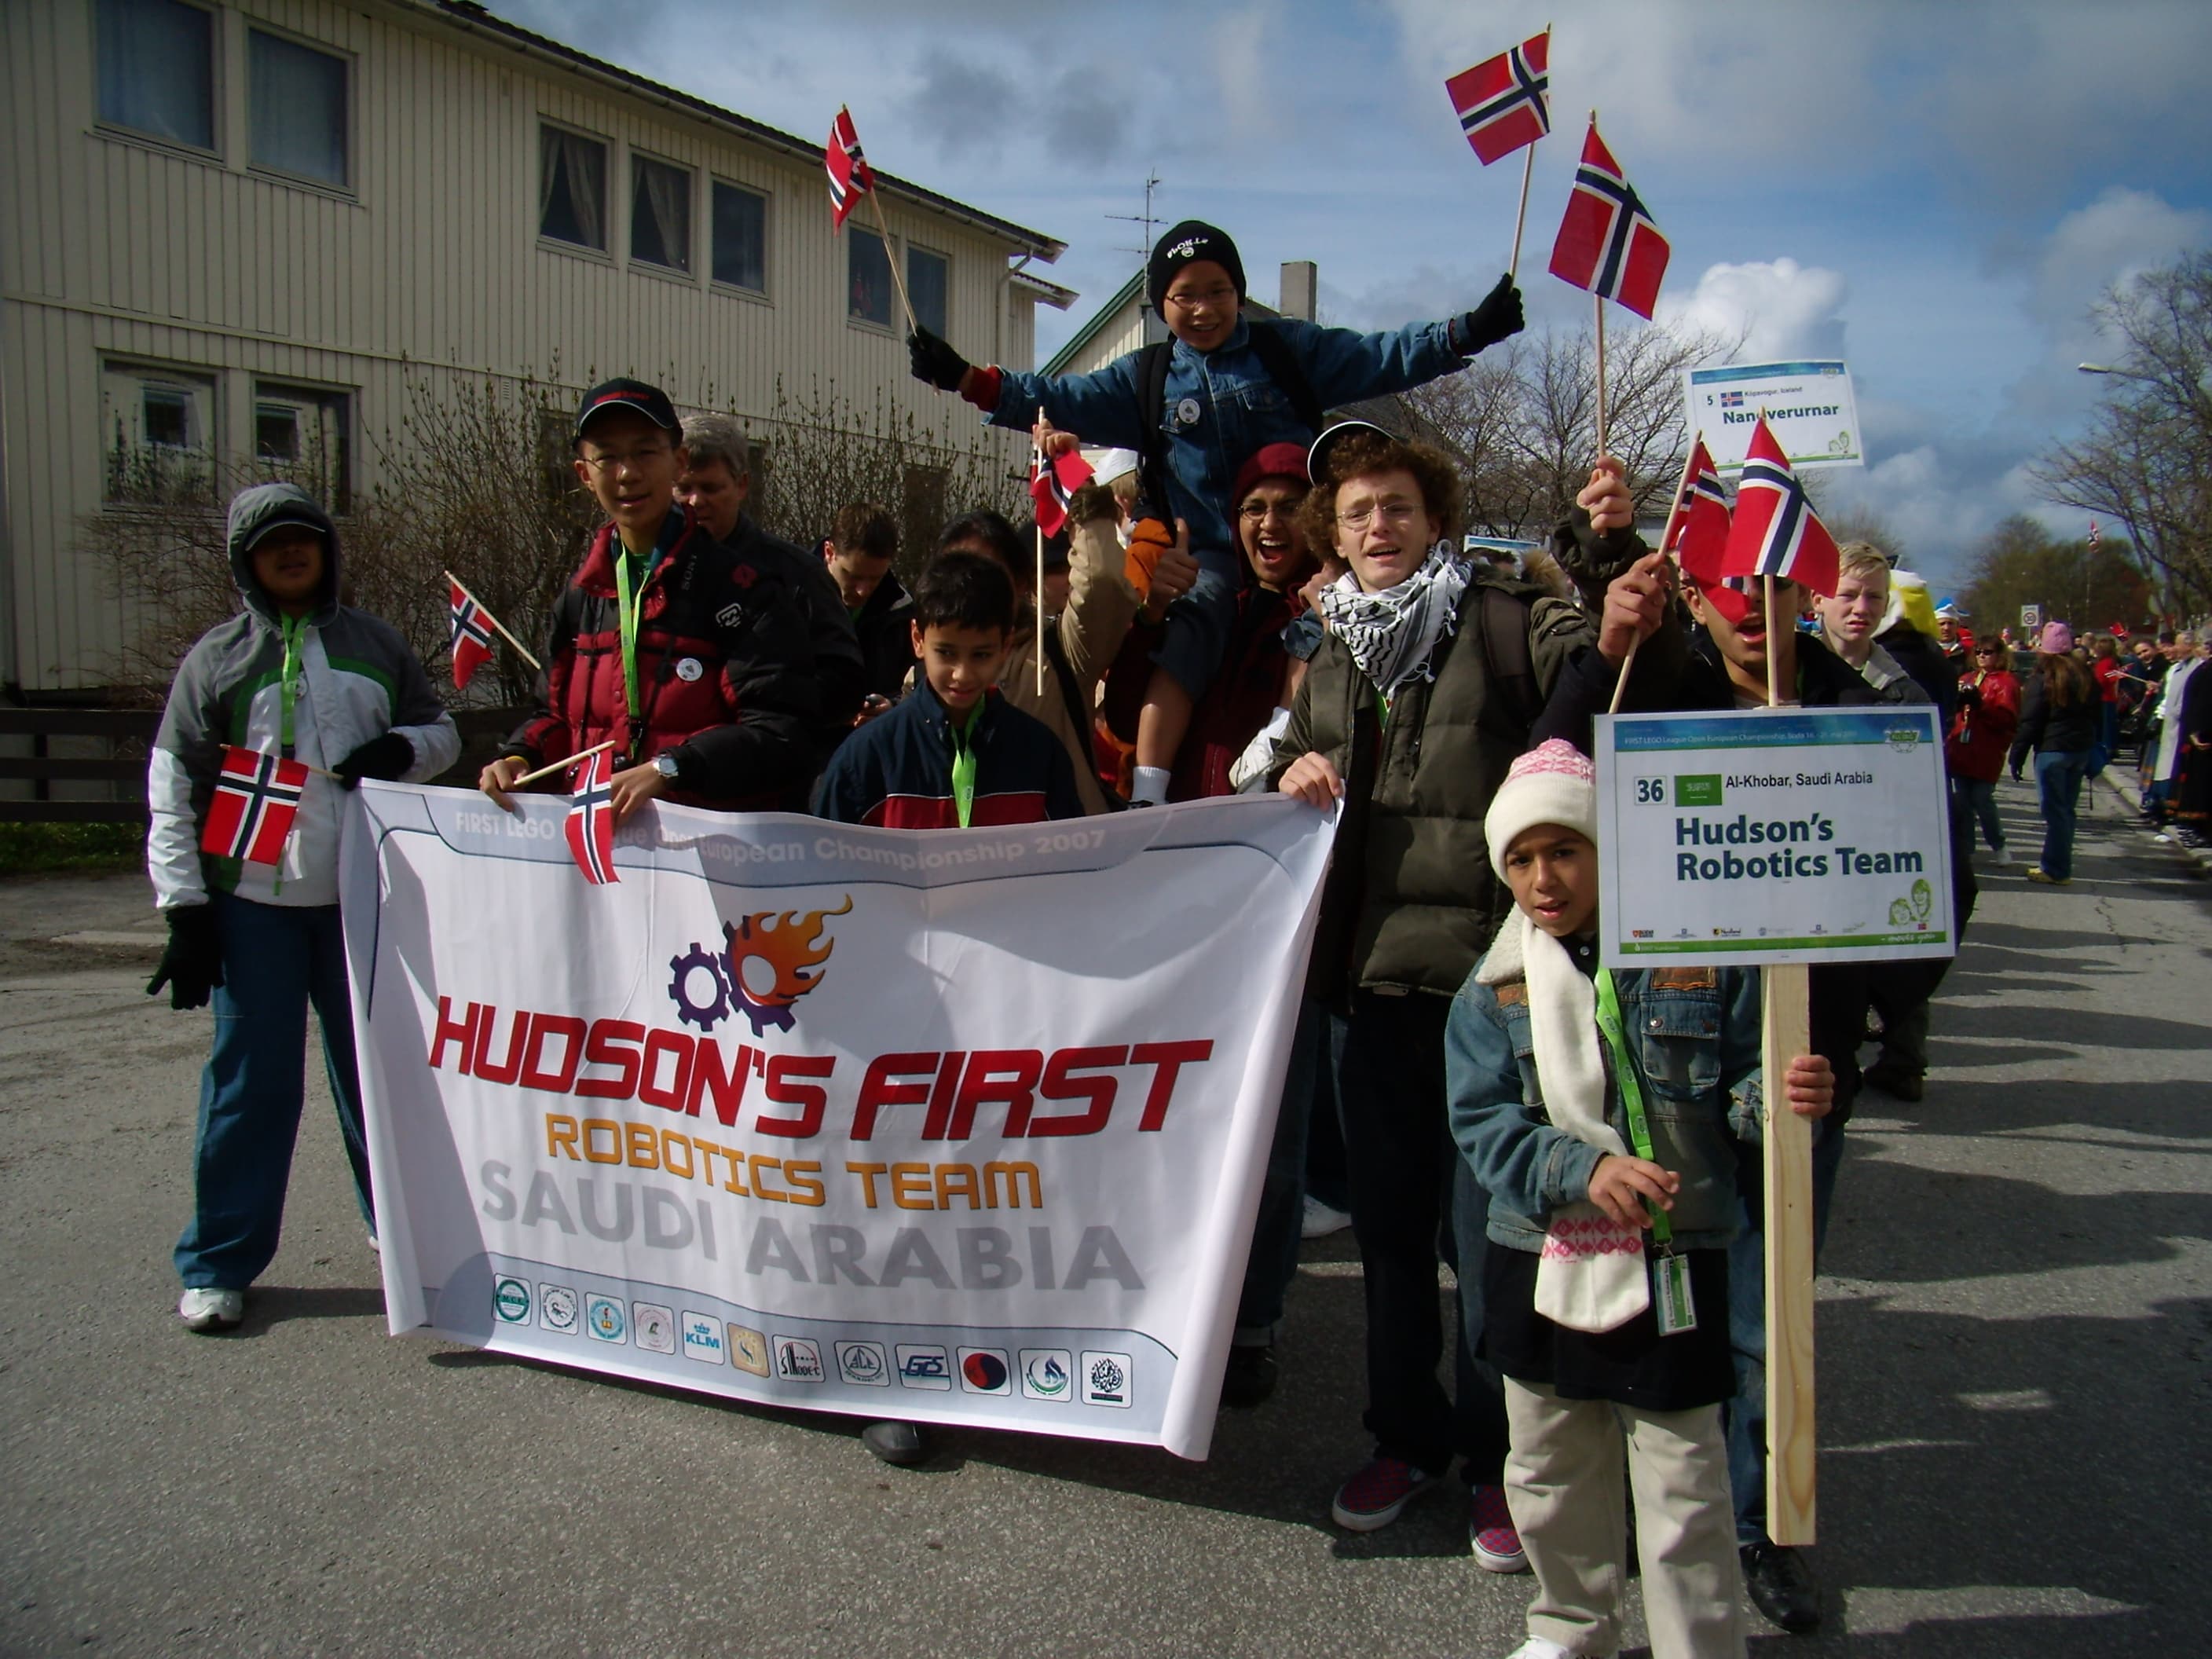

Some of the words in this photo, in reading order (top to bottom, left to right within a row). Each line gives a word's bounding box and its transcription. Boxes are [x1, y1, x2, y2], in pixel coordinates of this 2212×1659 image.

[1707, 395, 1713, 406] 5
[1637, 779, 1664, 803] 36
[1726, 775, 1793, 789] Al-Khobar,
[1796, 773, 1831, 786] Saudi
[1834, 771, 1873, 785] Arabia
[456, 811, 500, 836] FIRST
[507, 815, 555, 840] LEGO
[655, 824, 698, 851] Open
[700, 833, 805, 866] European
[815, 837, 1025, 870] Championship
[1035, 830, 1107, 855] 2007
[1677, 848, 1829, 881] Robotics
[1835, 847, 1923, 874] Team
[429, 995, 837, 1138] HUDSON'S
[850, 1039, 1214, 1141] FIRST
[545, 1112, 826, 1207] ROBOTICS
[846, 1160, 1043, 1210] TEAM
[480, 1159, 717, 1262] SAUDI
[745, 1216, 1145, 1291] ARABIA
[685, 1331, 720, 1349] KLM
